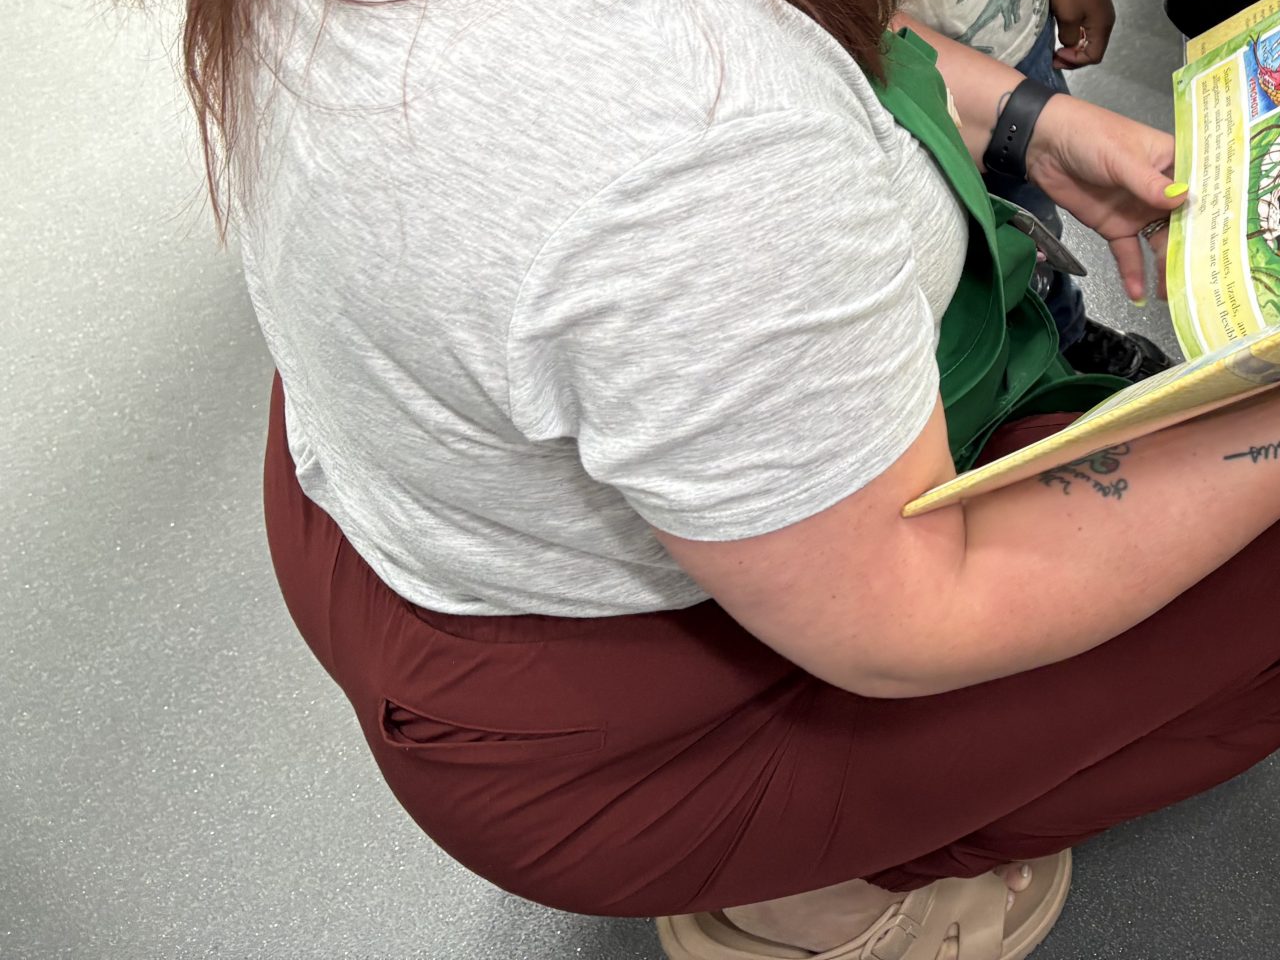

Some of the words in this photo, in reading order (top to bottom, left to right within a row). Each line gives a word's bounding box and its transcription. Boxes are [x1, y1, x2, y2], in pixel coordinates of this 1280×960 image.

[1223, 67, 1232, 92] Snakes
[1249, 77, 1259, 118] VENOMOUS
[1226, 109, 1235, 136] reptiles.
[1227, 139, 1235, 163] Unlike
[1226, 169, 1234, 184] other
[1223, 217, 1231, 234] such
[1210, 272, 1220, 285] dry
[1214, 289, 1225, 307] and
[1226, 281, 1240, 318] lizards,
